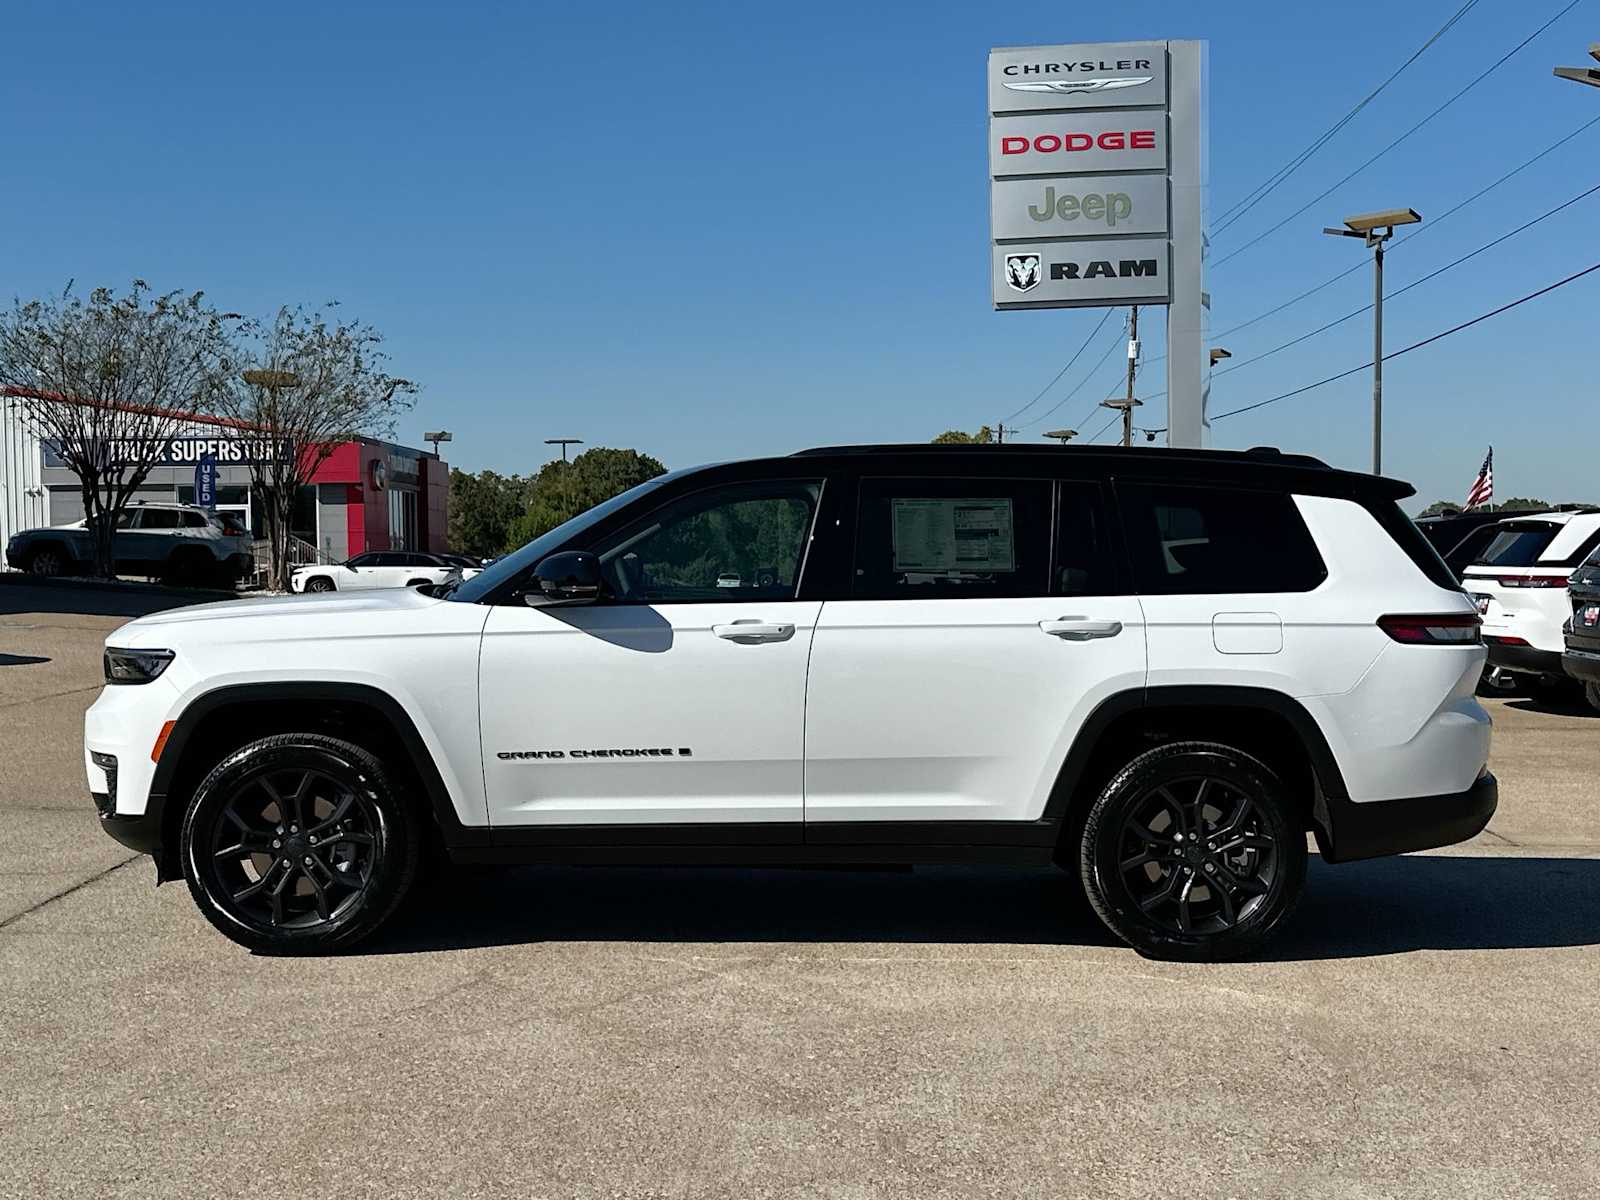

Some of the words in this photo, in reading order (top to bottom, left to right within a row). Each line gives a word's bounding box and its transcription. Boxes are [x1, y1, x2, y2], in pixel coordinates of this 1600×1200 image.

[1003, 59, 1151, 76] CHRYSLER
[1002, 131, 1156, 155] DODGE
[1028, 186, 1132, 226] Jeep
[1050, 259, 1158, 280] RAM
[201, 464, 211, 502] USED
[497, 750, 565, 760] GRAND
[569, 748, 673, 758] CHEROKEE
